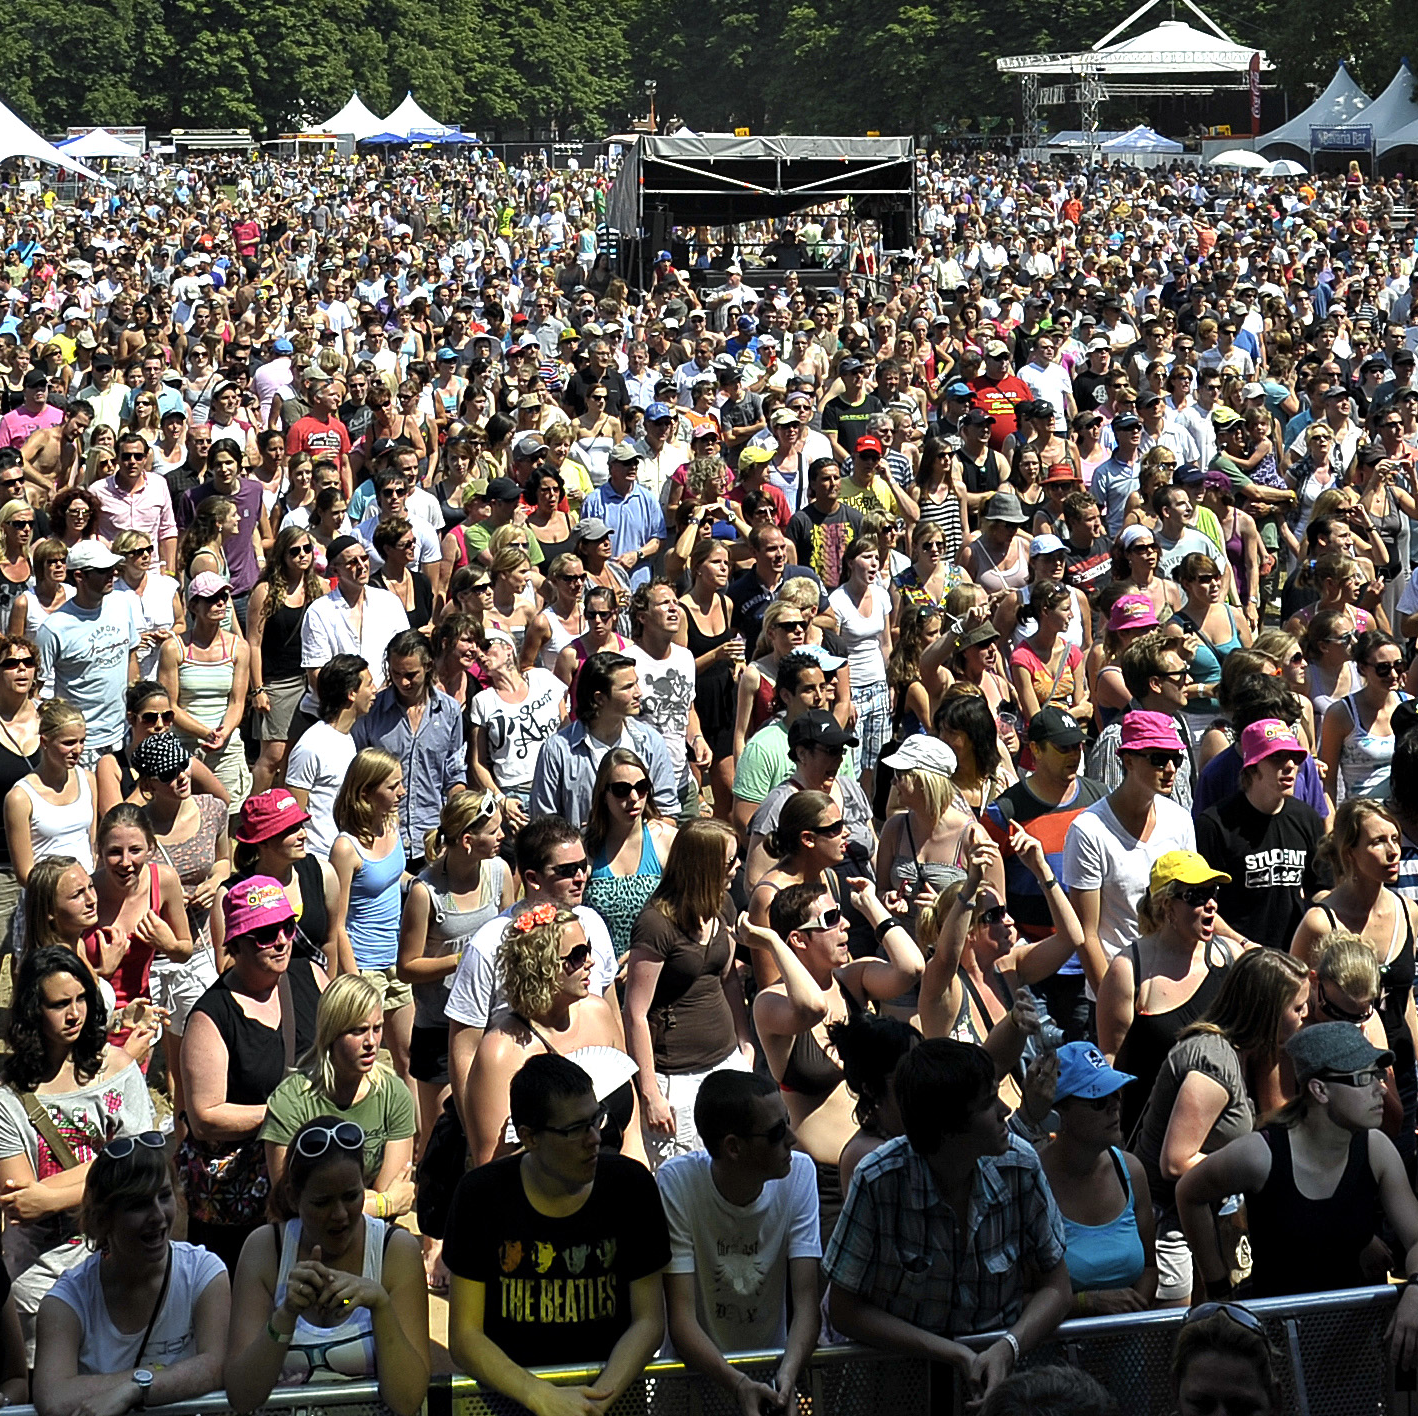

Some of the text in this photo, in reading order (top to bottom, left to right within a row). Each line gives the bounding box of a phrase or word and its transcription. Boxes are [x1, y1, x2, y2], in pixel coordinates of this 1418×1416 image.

[1352, 131, 1367, 146] Bar
[1244, 848, 1308, 870] STUDENT
[499, 1273, 617, 1323] THE BEATLES
